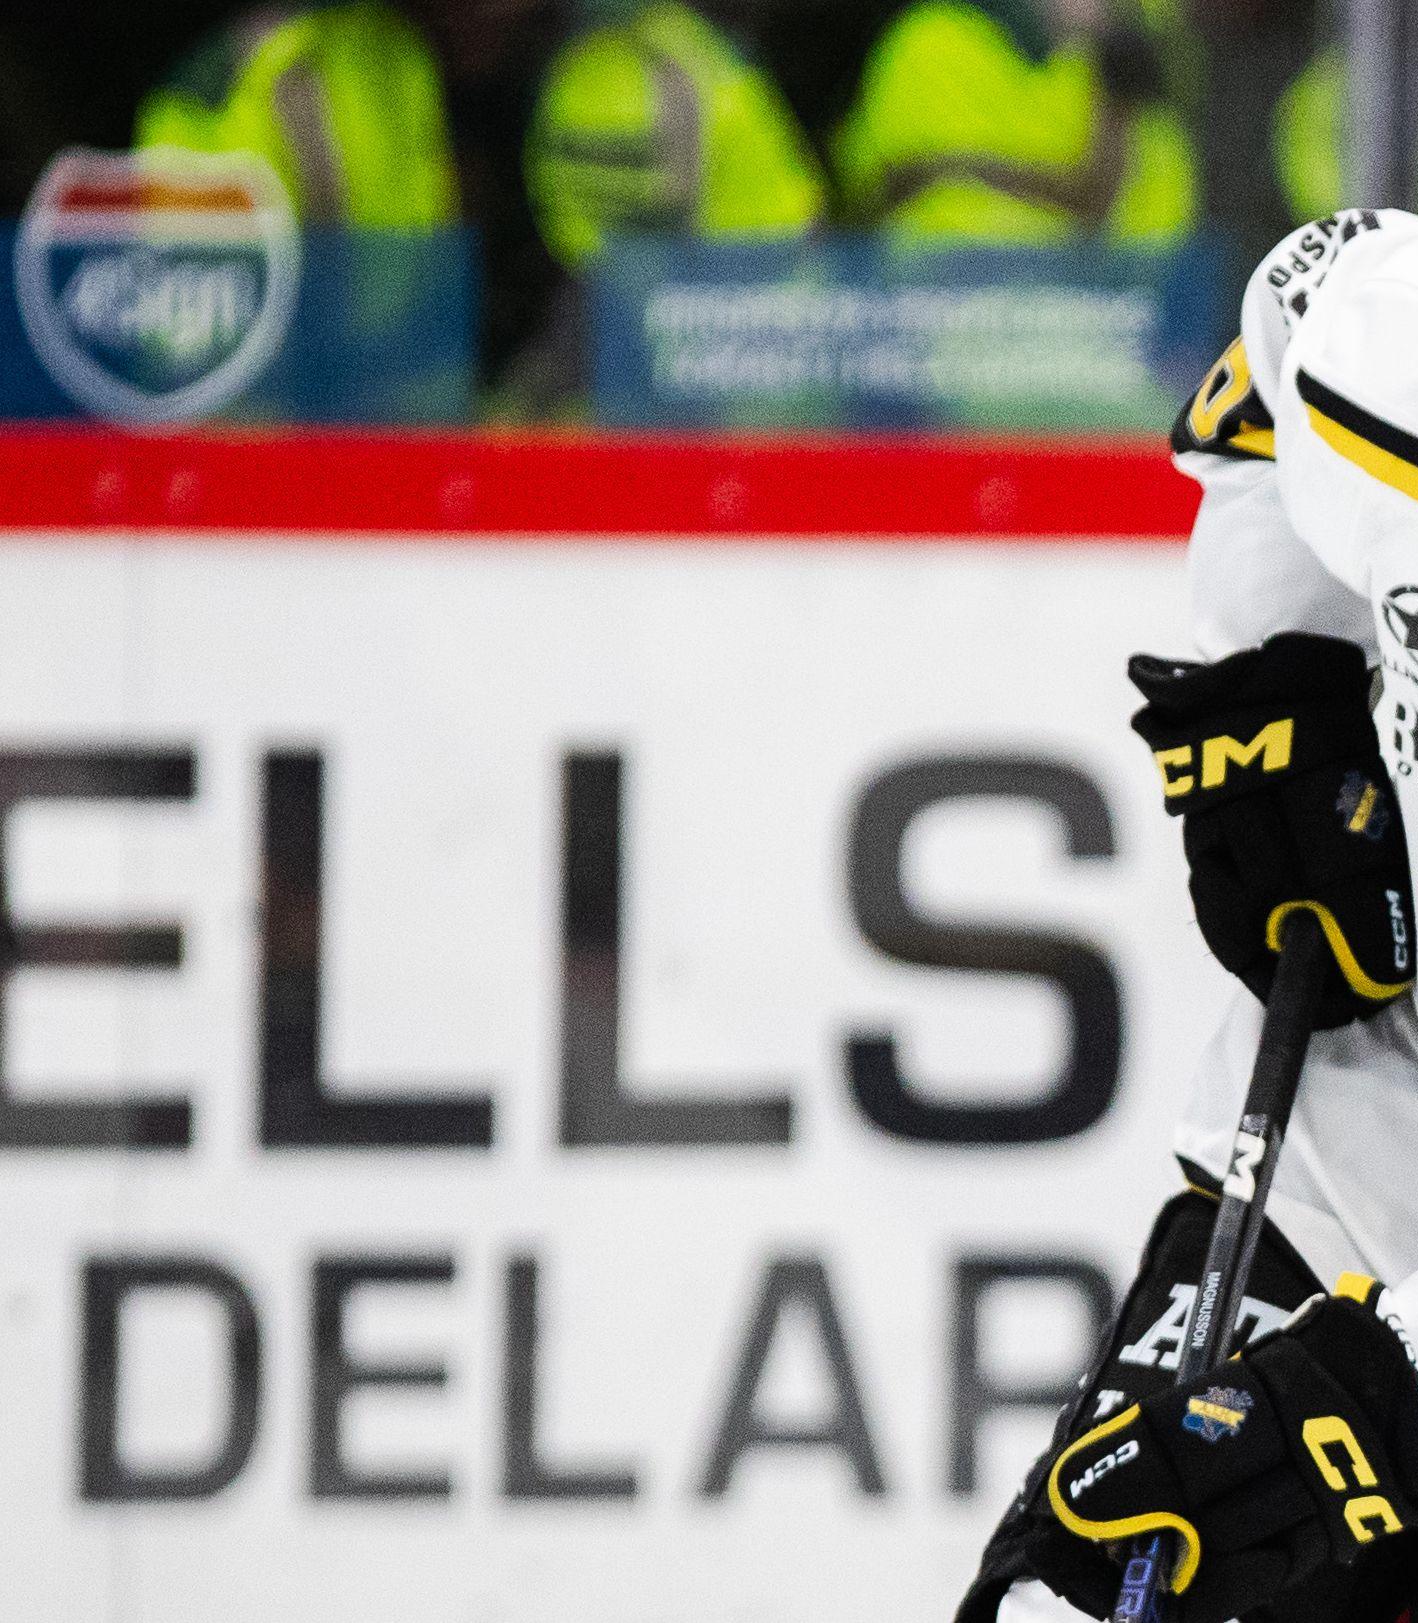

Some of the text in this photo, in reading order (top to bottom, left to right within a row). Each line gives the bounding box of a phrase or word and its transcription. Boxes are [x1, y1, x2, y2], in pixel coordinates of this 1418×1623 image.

[1385, 888, 1408, 971] CCM
[1191, 1271, 1222, 1347] MAGNUSSON
[1070, 1439, 1140, 1499] CCM
